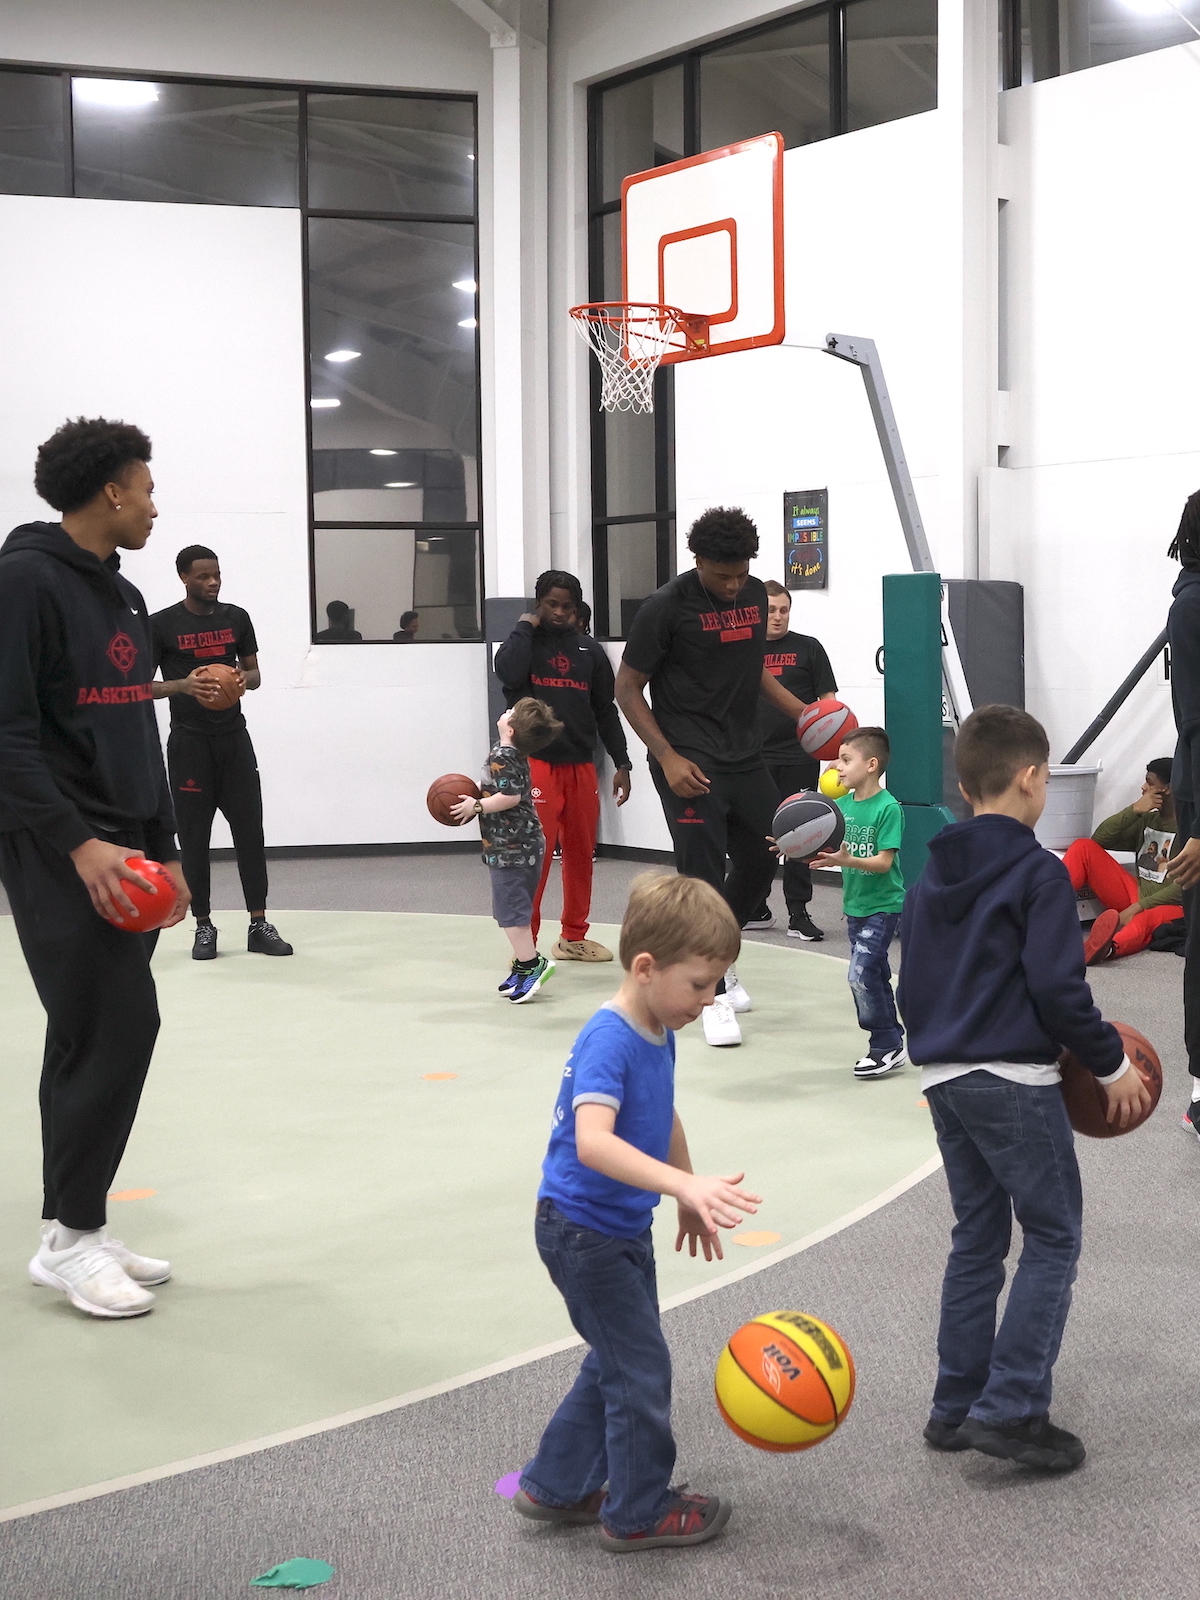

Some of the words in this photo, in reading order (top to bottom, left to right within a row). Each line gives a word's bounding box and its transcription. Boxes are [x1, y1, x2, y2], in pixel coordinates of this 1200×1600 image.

[792, 505, 799, 517] It
[800, 505, 820, 518] always
[796, 518, 816, 527] SEEMS
[787, 531, 823, 543] IMPSIBLE
[804, 562, 821, 577] done
[699, 612, 721, 631] LEE
[721, 605, 761, 628] COLLEGE
[177, 633, 197, 650] LEE
[197, 628, 236, 648] COLLEGE
[763, 653, 797, 667] OLLEGE
[762, 1343, 801, 1382] Voit
